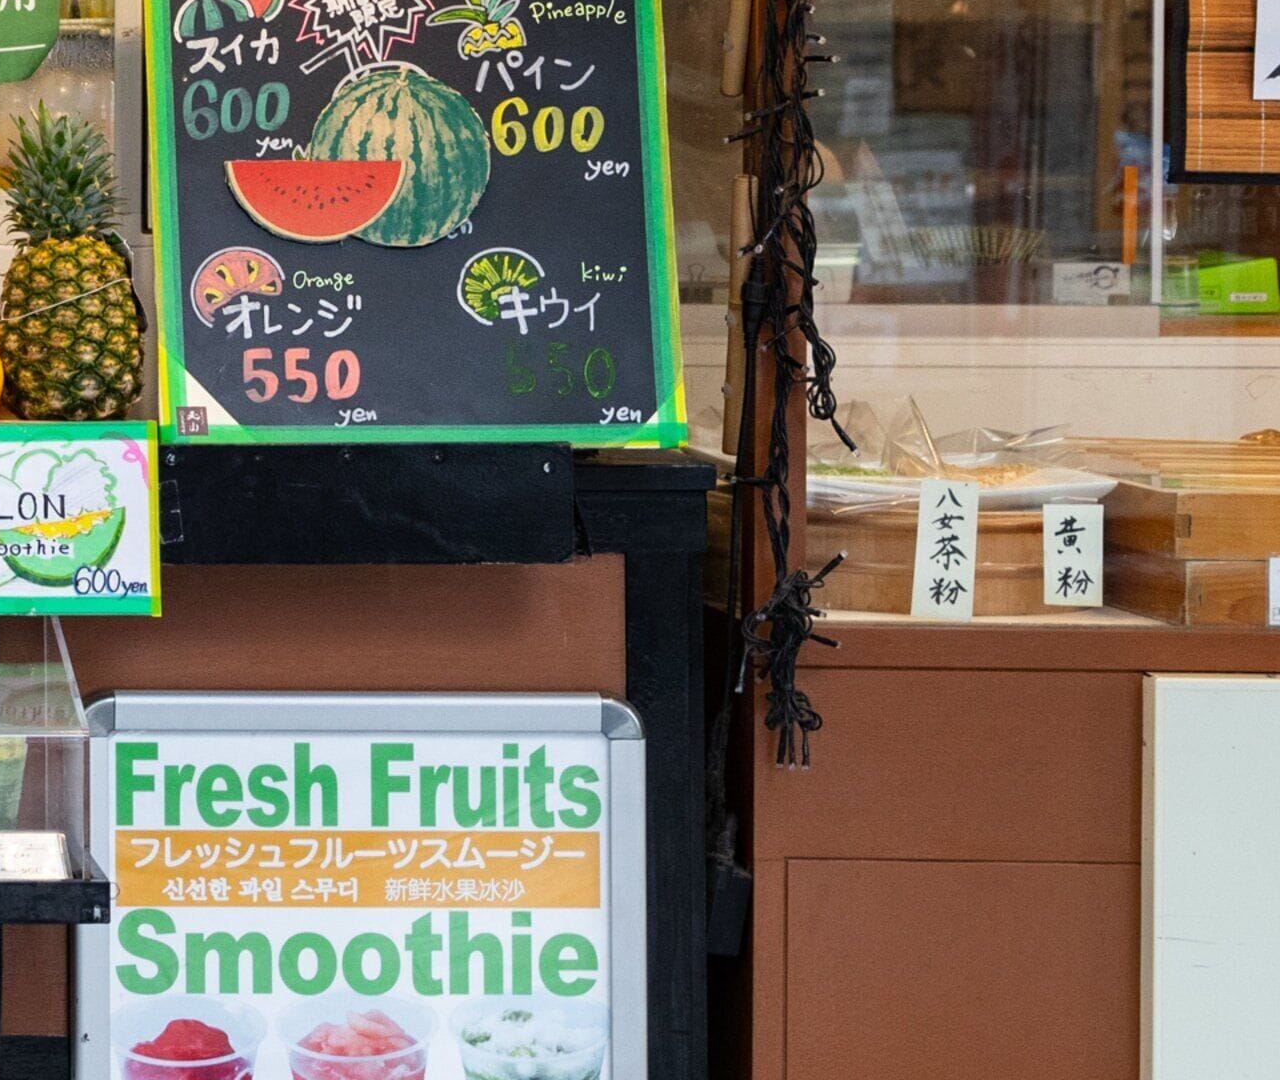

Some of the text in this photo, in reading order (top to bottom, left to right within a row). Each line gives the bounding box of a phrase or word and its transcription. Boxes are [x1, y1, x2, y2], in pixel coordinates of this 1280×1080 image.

[186, 28, 280, 74] スイカ
[475, 50, 596, 94] パイン
[182, 79, 291, 142] 600
[491, 96, 605, 157] 600
[255, 135, 294, 158] yen
[583, 159, 630, 181] yen
[292, 270, 355, 292] Orange
[581, 261, 628, 283] kiwi
[222, 294, 363, 340] オレンジ
[498, 285, 601, 336] キウイ
[242, 347, 361, 404] 550
[504, 340, 616, 400] 550
[334, 407, 378, 428] yen
[598, 405, 643, 426] yen
[929, 487, 968, 606] 八女茶粉
[114, 741, 603, 830] Fresh Fruits
[130, 835, 587, 871] フレッシュフルーツスムージー
[162, 877, 360, 902] 신선한 과일 스무디
[113, 906, 601, 999] Smoothie
